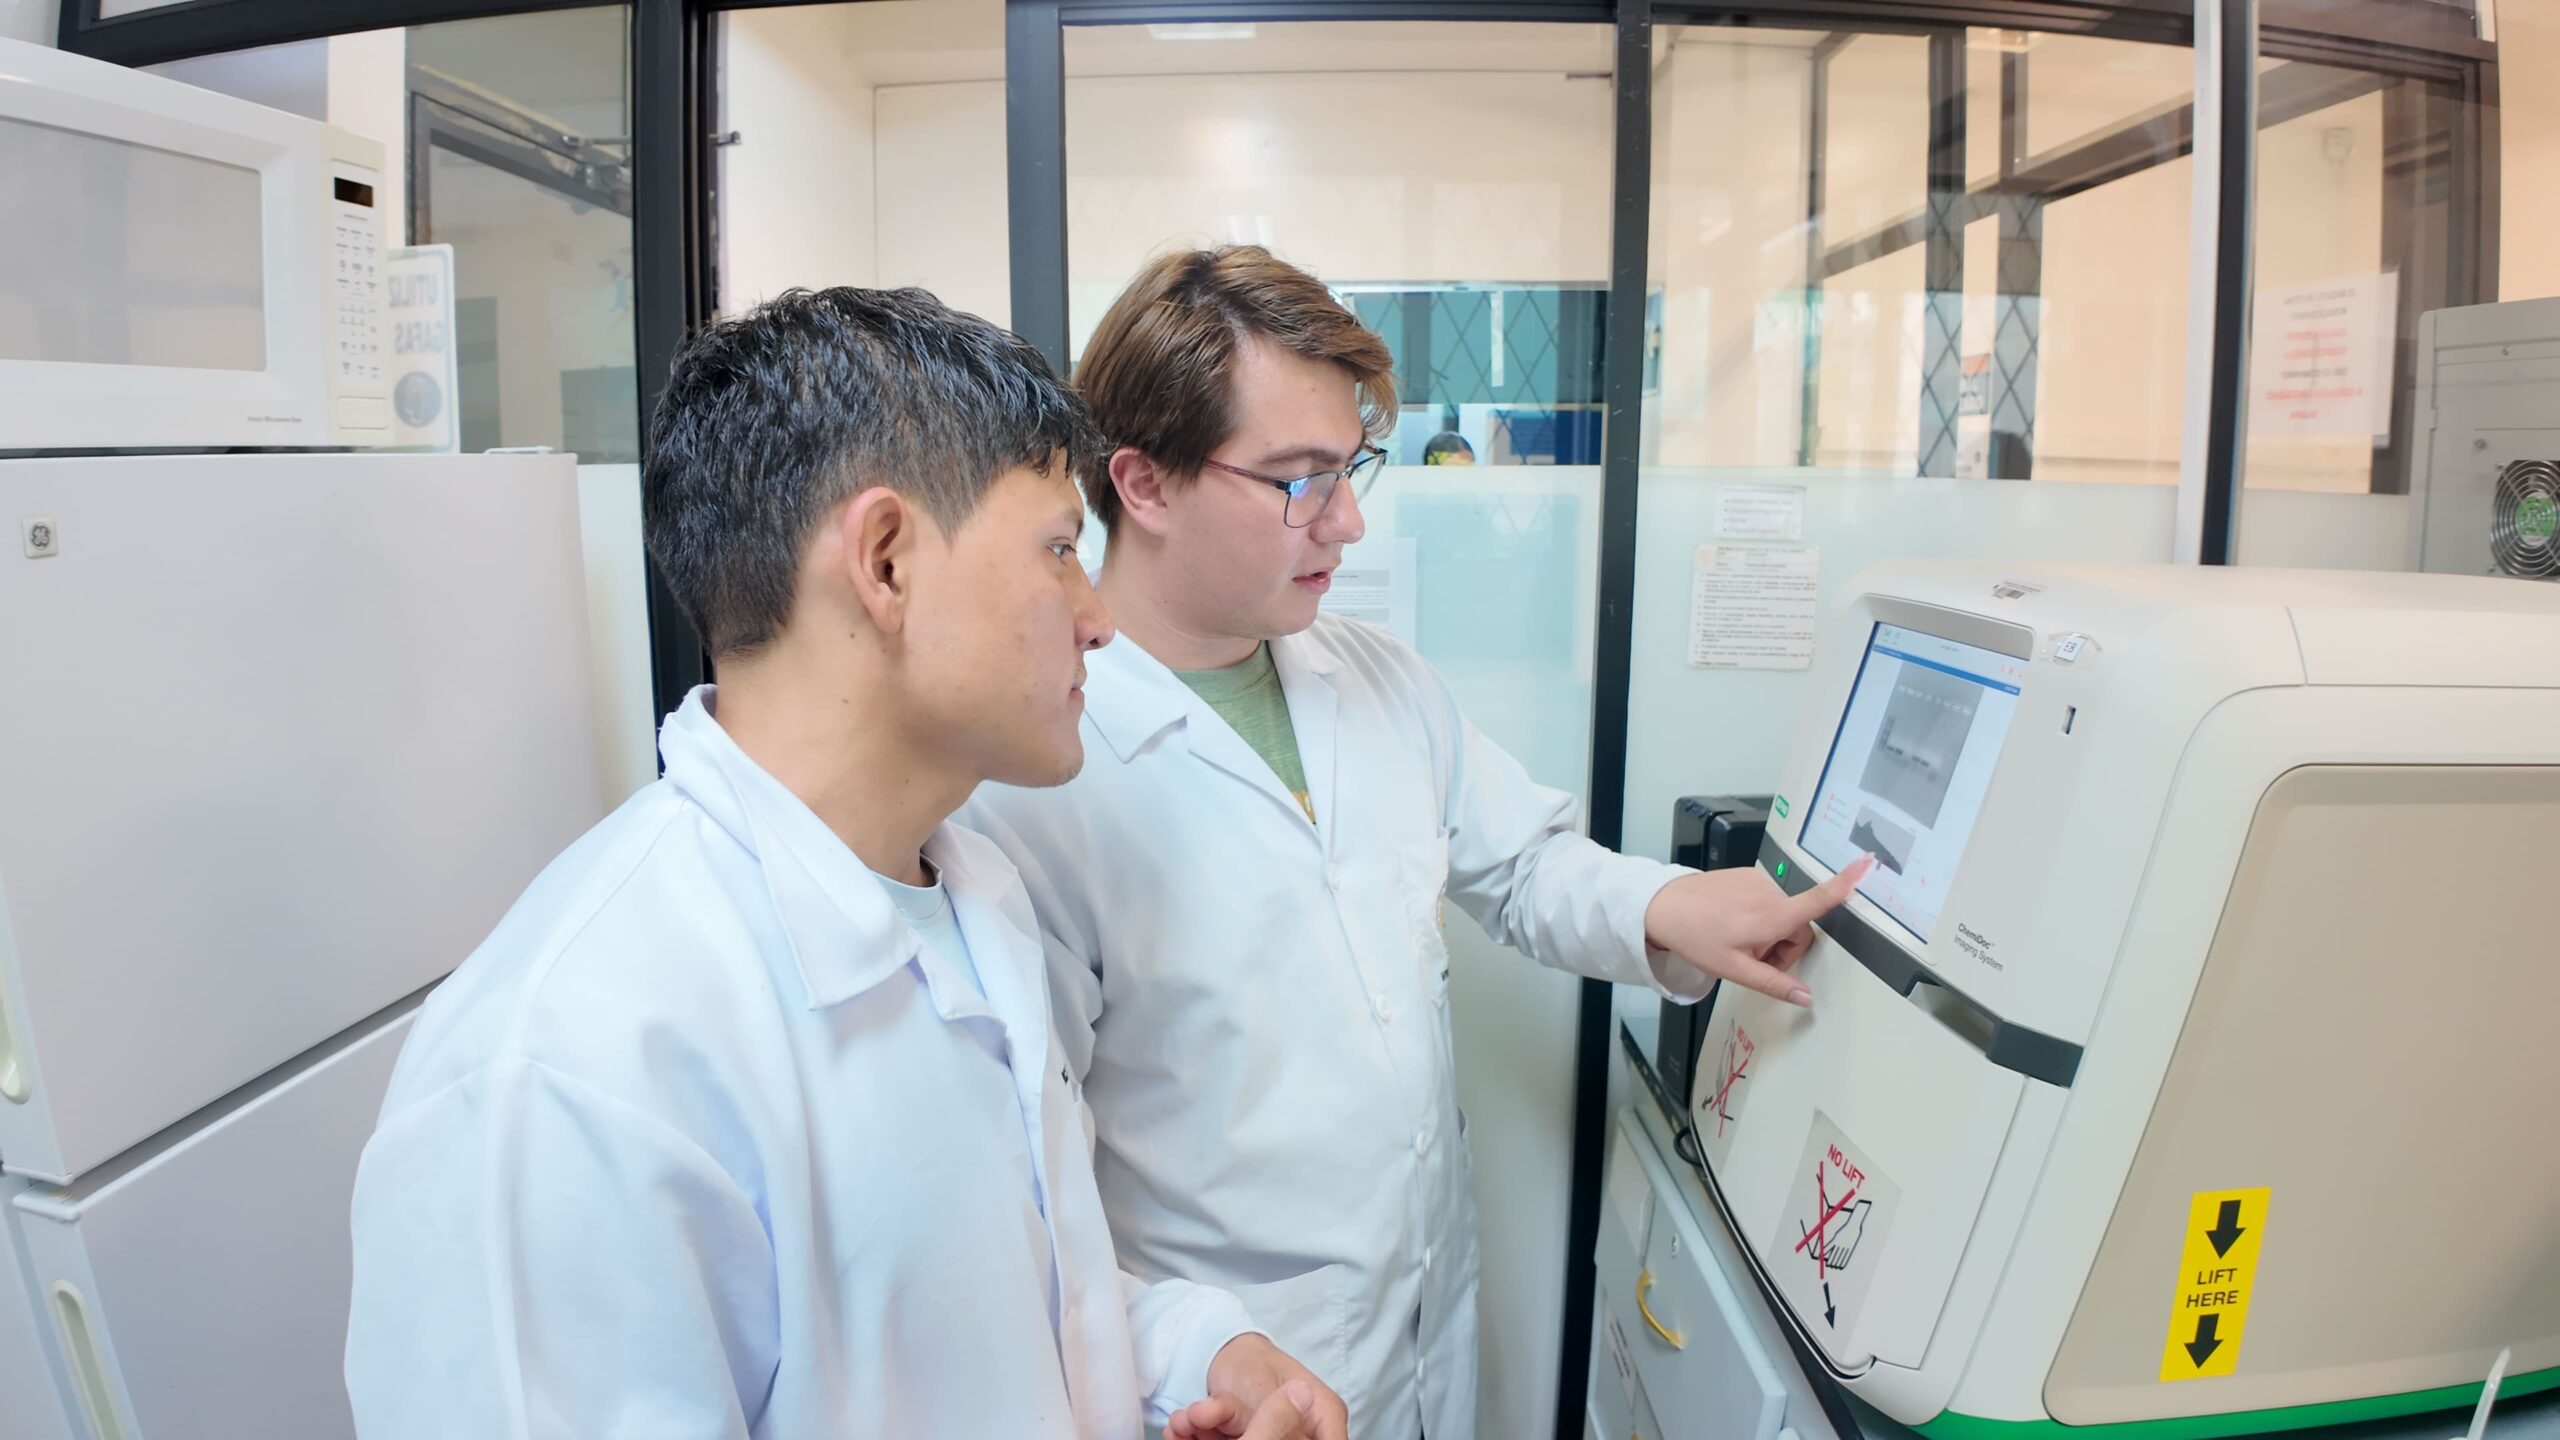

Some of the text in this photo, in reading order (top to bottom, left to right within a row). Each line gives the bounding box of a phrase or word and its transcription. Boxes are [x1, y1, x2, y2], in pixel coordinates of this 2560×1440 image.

[1953, 935, 2003, 972] Imaging System
[1828, 1143, 1865, 1189] NO LIFT
[2197, 1267, 2238, 1285] LIFT
[2186, 1290, 2239, 1308] HERE
